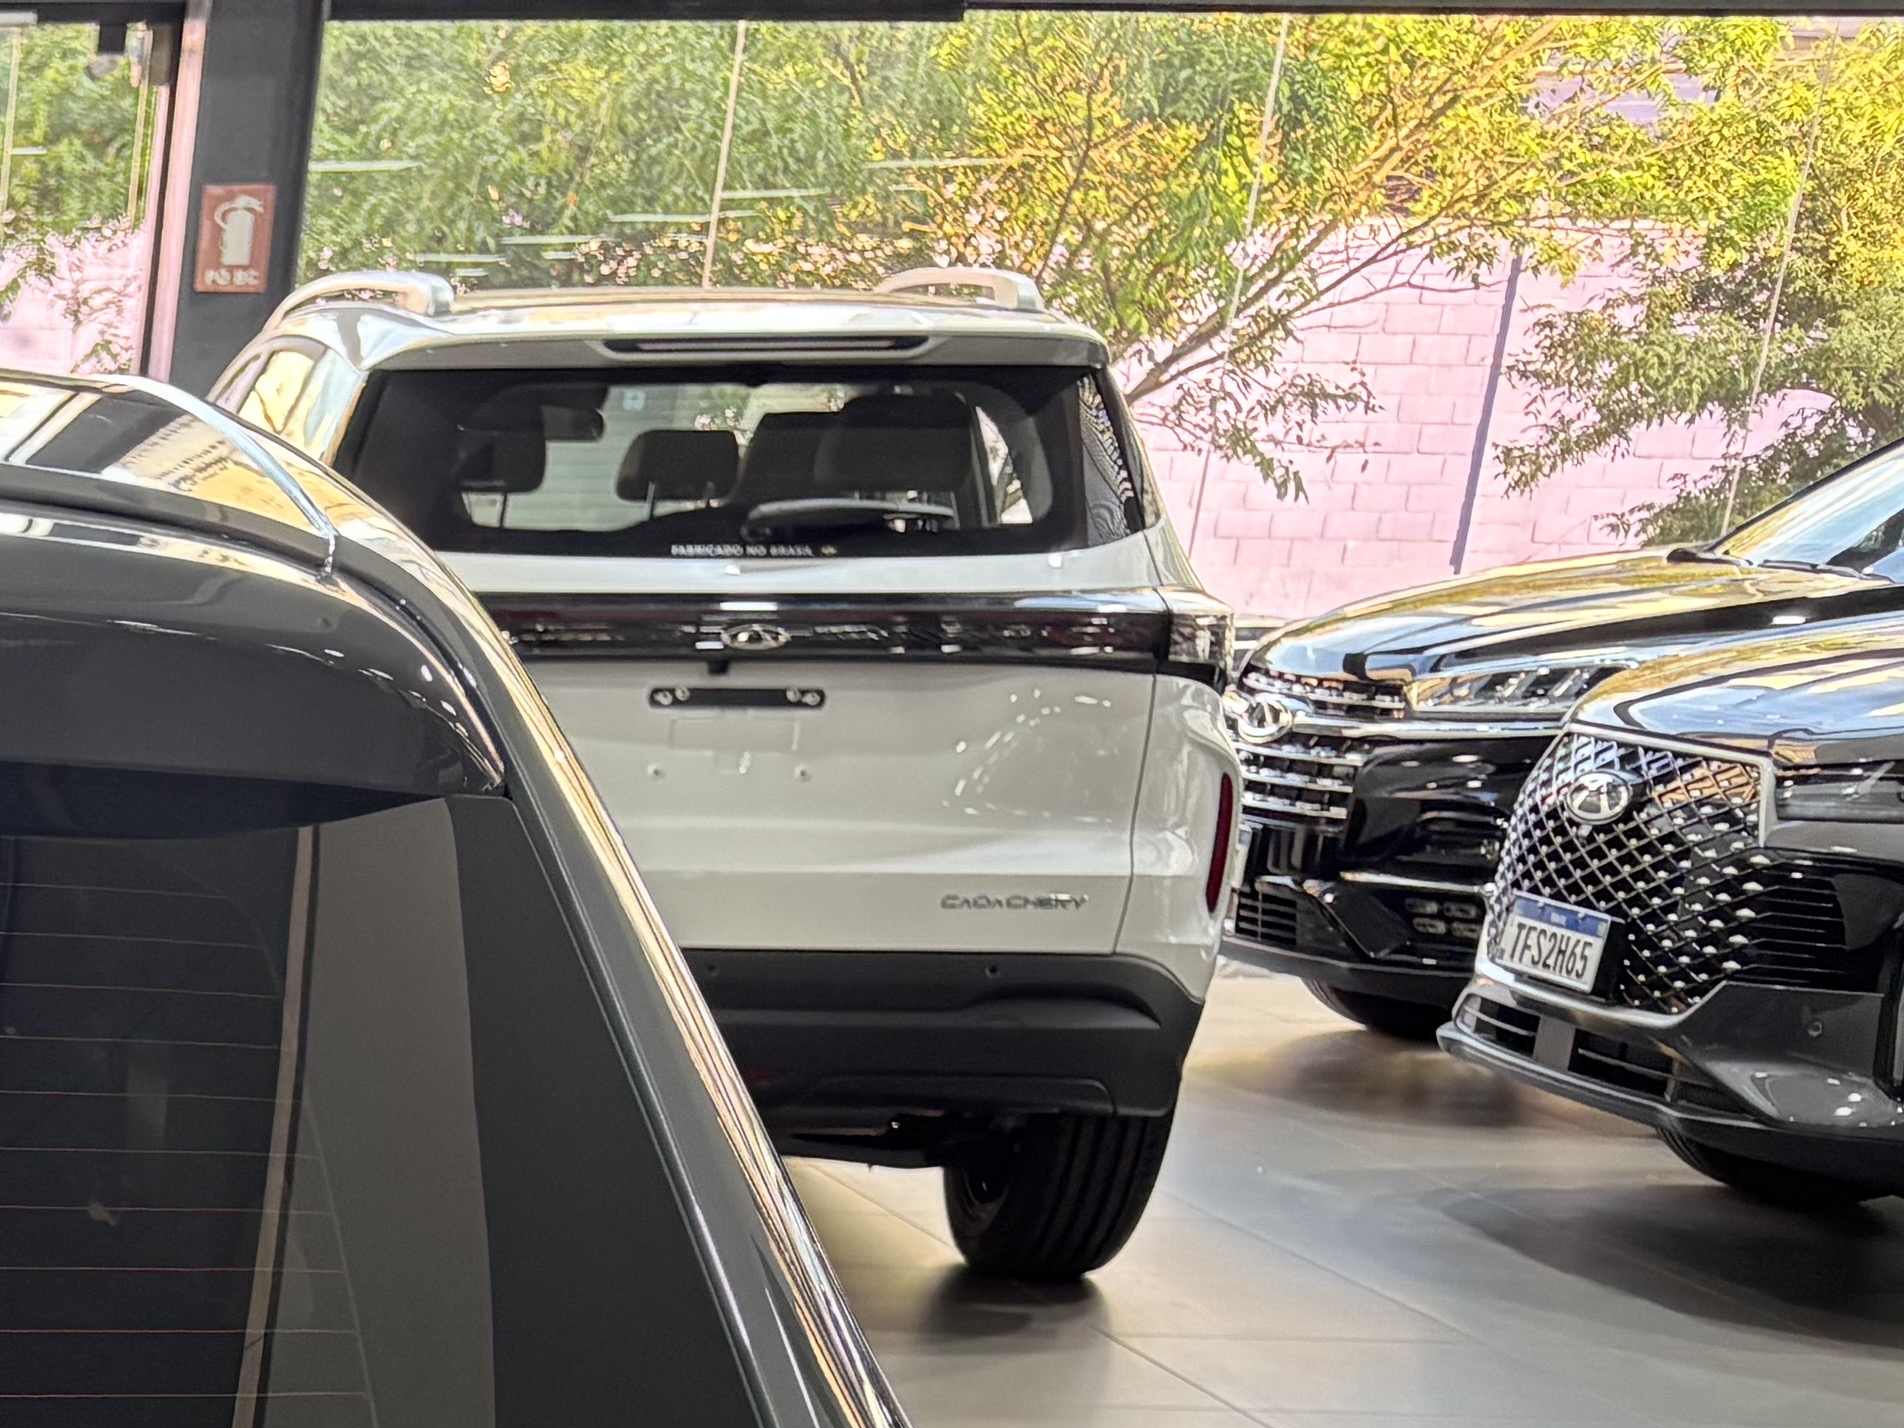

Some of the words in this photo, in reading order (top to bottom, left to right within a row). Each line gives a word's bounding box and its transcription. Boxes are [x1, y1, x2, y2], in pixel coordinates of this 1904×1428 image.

[671, 544, 743, 556] FABRICADO
[745, 544, 767, 556] NO
[1510, 922, 1594, 979] TFS2H65
